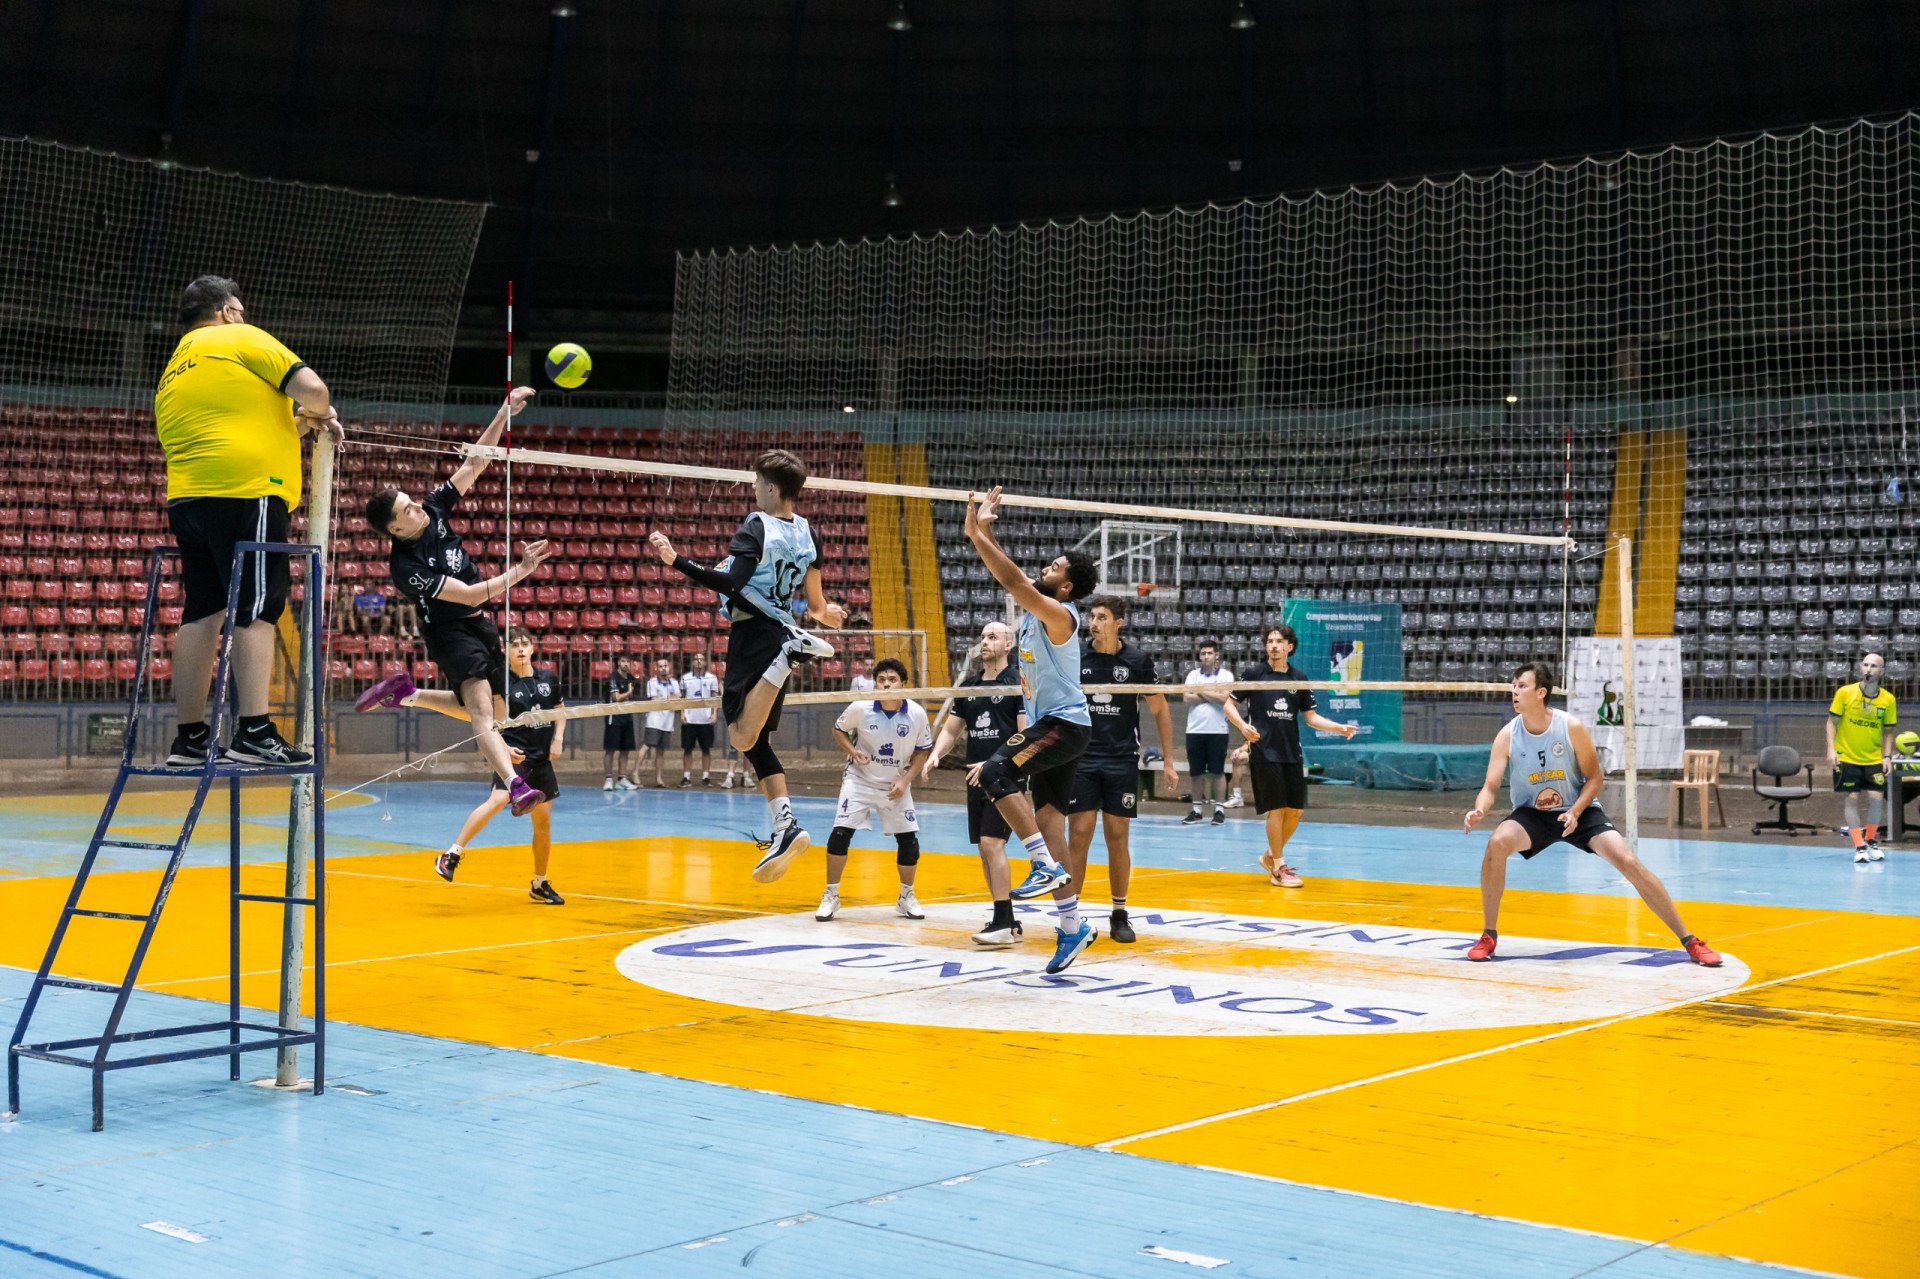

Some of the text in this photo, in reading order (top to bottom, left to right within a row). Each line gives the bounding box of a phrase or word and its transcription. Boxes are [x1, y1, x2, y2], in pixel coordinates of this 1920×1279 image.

[156, 358, 197, 394] EDEL
[969, 728, 1000, 738] VemSer
[1537, 750, 1546, 767] 5
[841, 798, 849, 813] 4
[822, 953, 1429, 1026] UNISINOS
